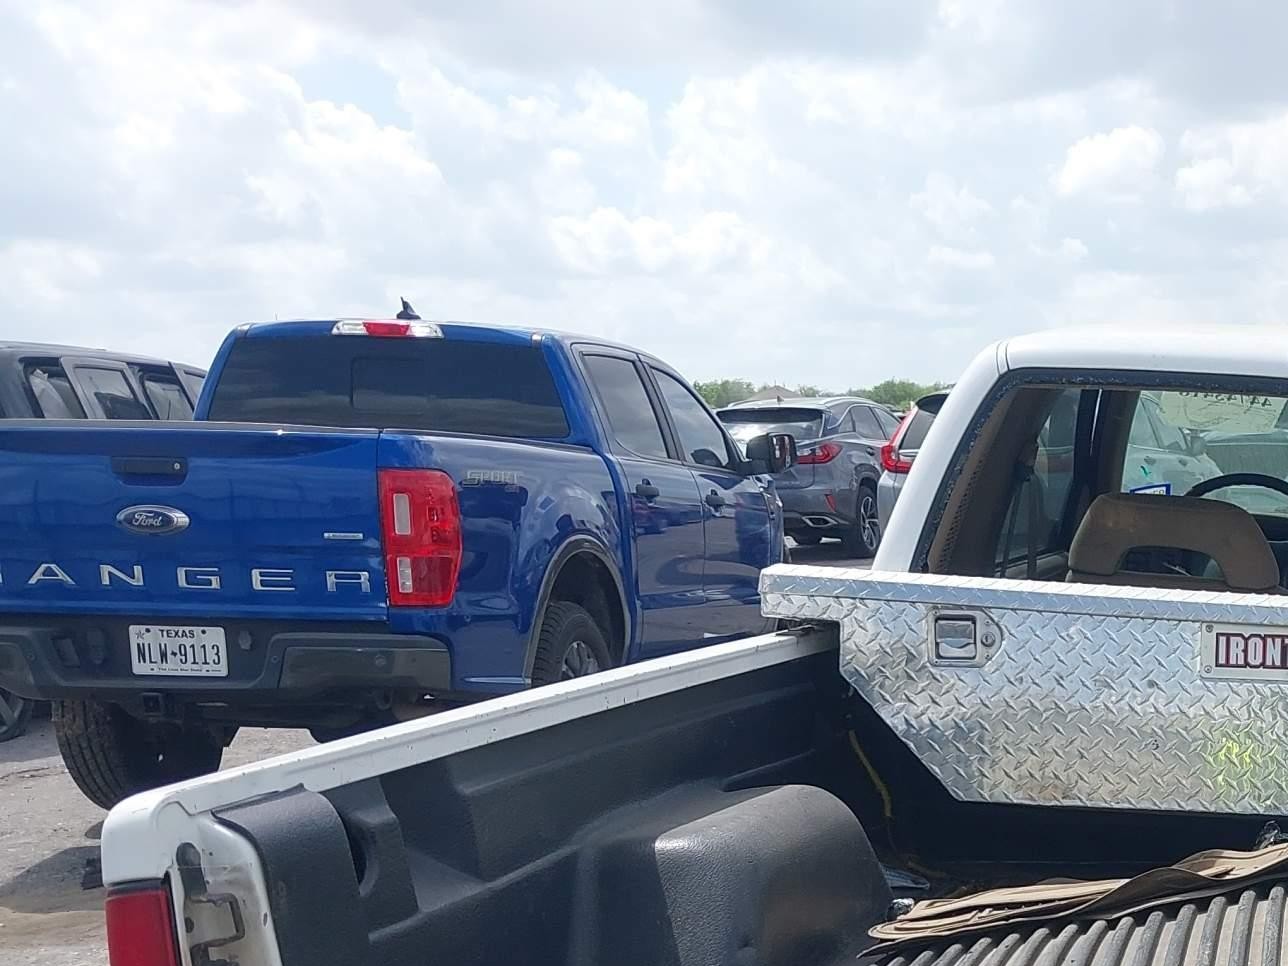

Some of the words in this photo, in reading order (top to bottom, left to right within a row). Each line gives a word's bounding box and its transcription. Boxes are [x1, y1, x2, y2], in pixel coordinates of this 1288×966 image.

[132, 512, 162, 526] Ford
[0, 563, 371, 593] ANGER
[159, 628, 196, 639] TEXAS
